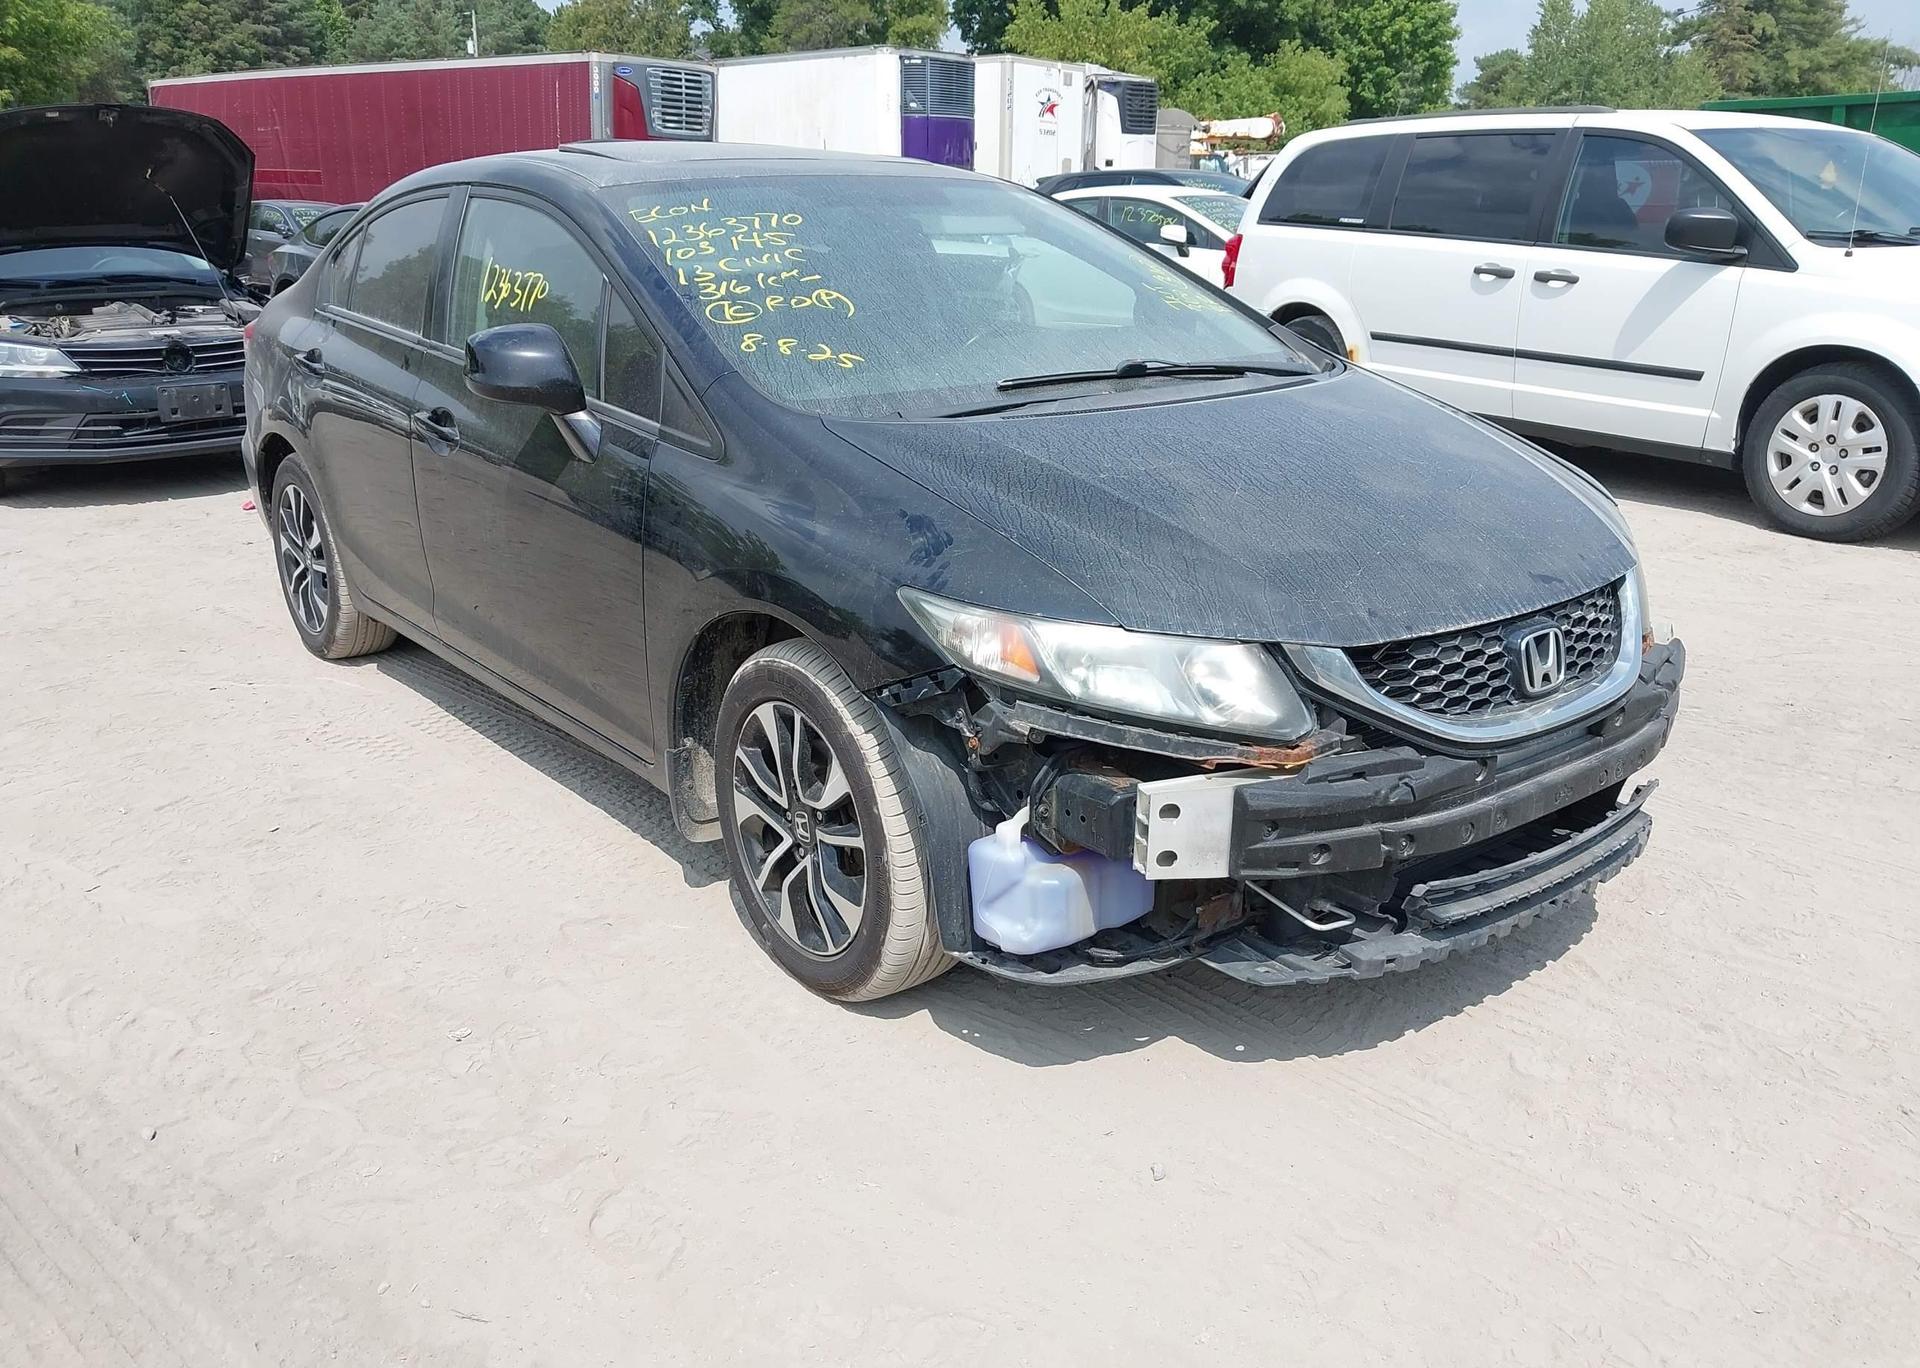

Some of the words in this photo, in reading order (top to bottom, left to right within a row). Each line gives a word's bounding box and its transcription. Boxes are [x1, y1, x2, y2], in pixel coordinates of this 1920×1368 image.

[629, 198, 713, 223] ECON
[678, 264, 716, 286] 13
[718, 247, 807, 273] CIVIC
[698, 279, 752, 300] 316
